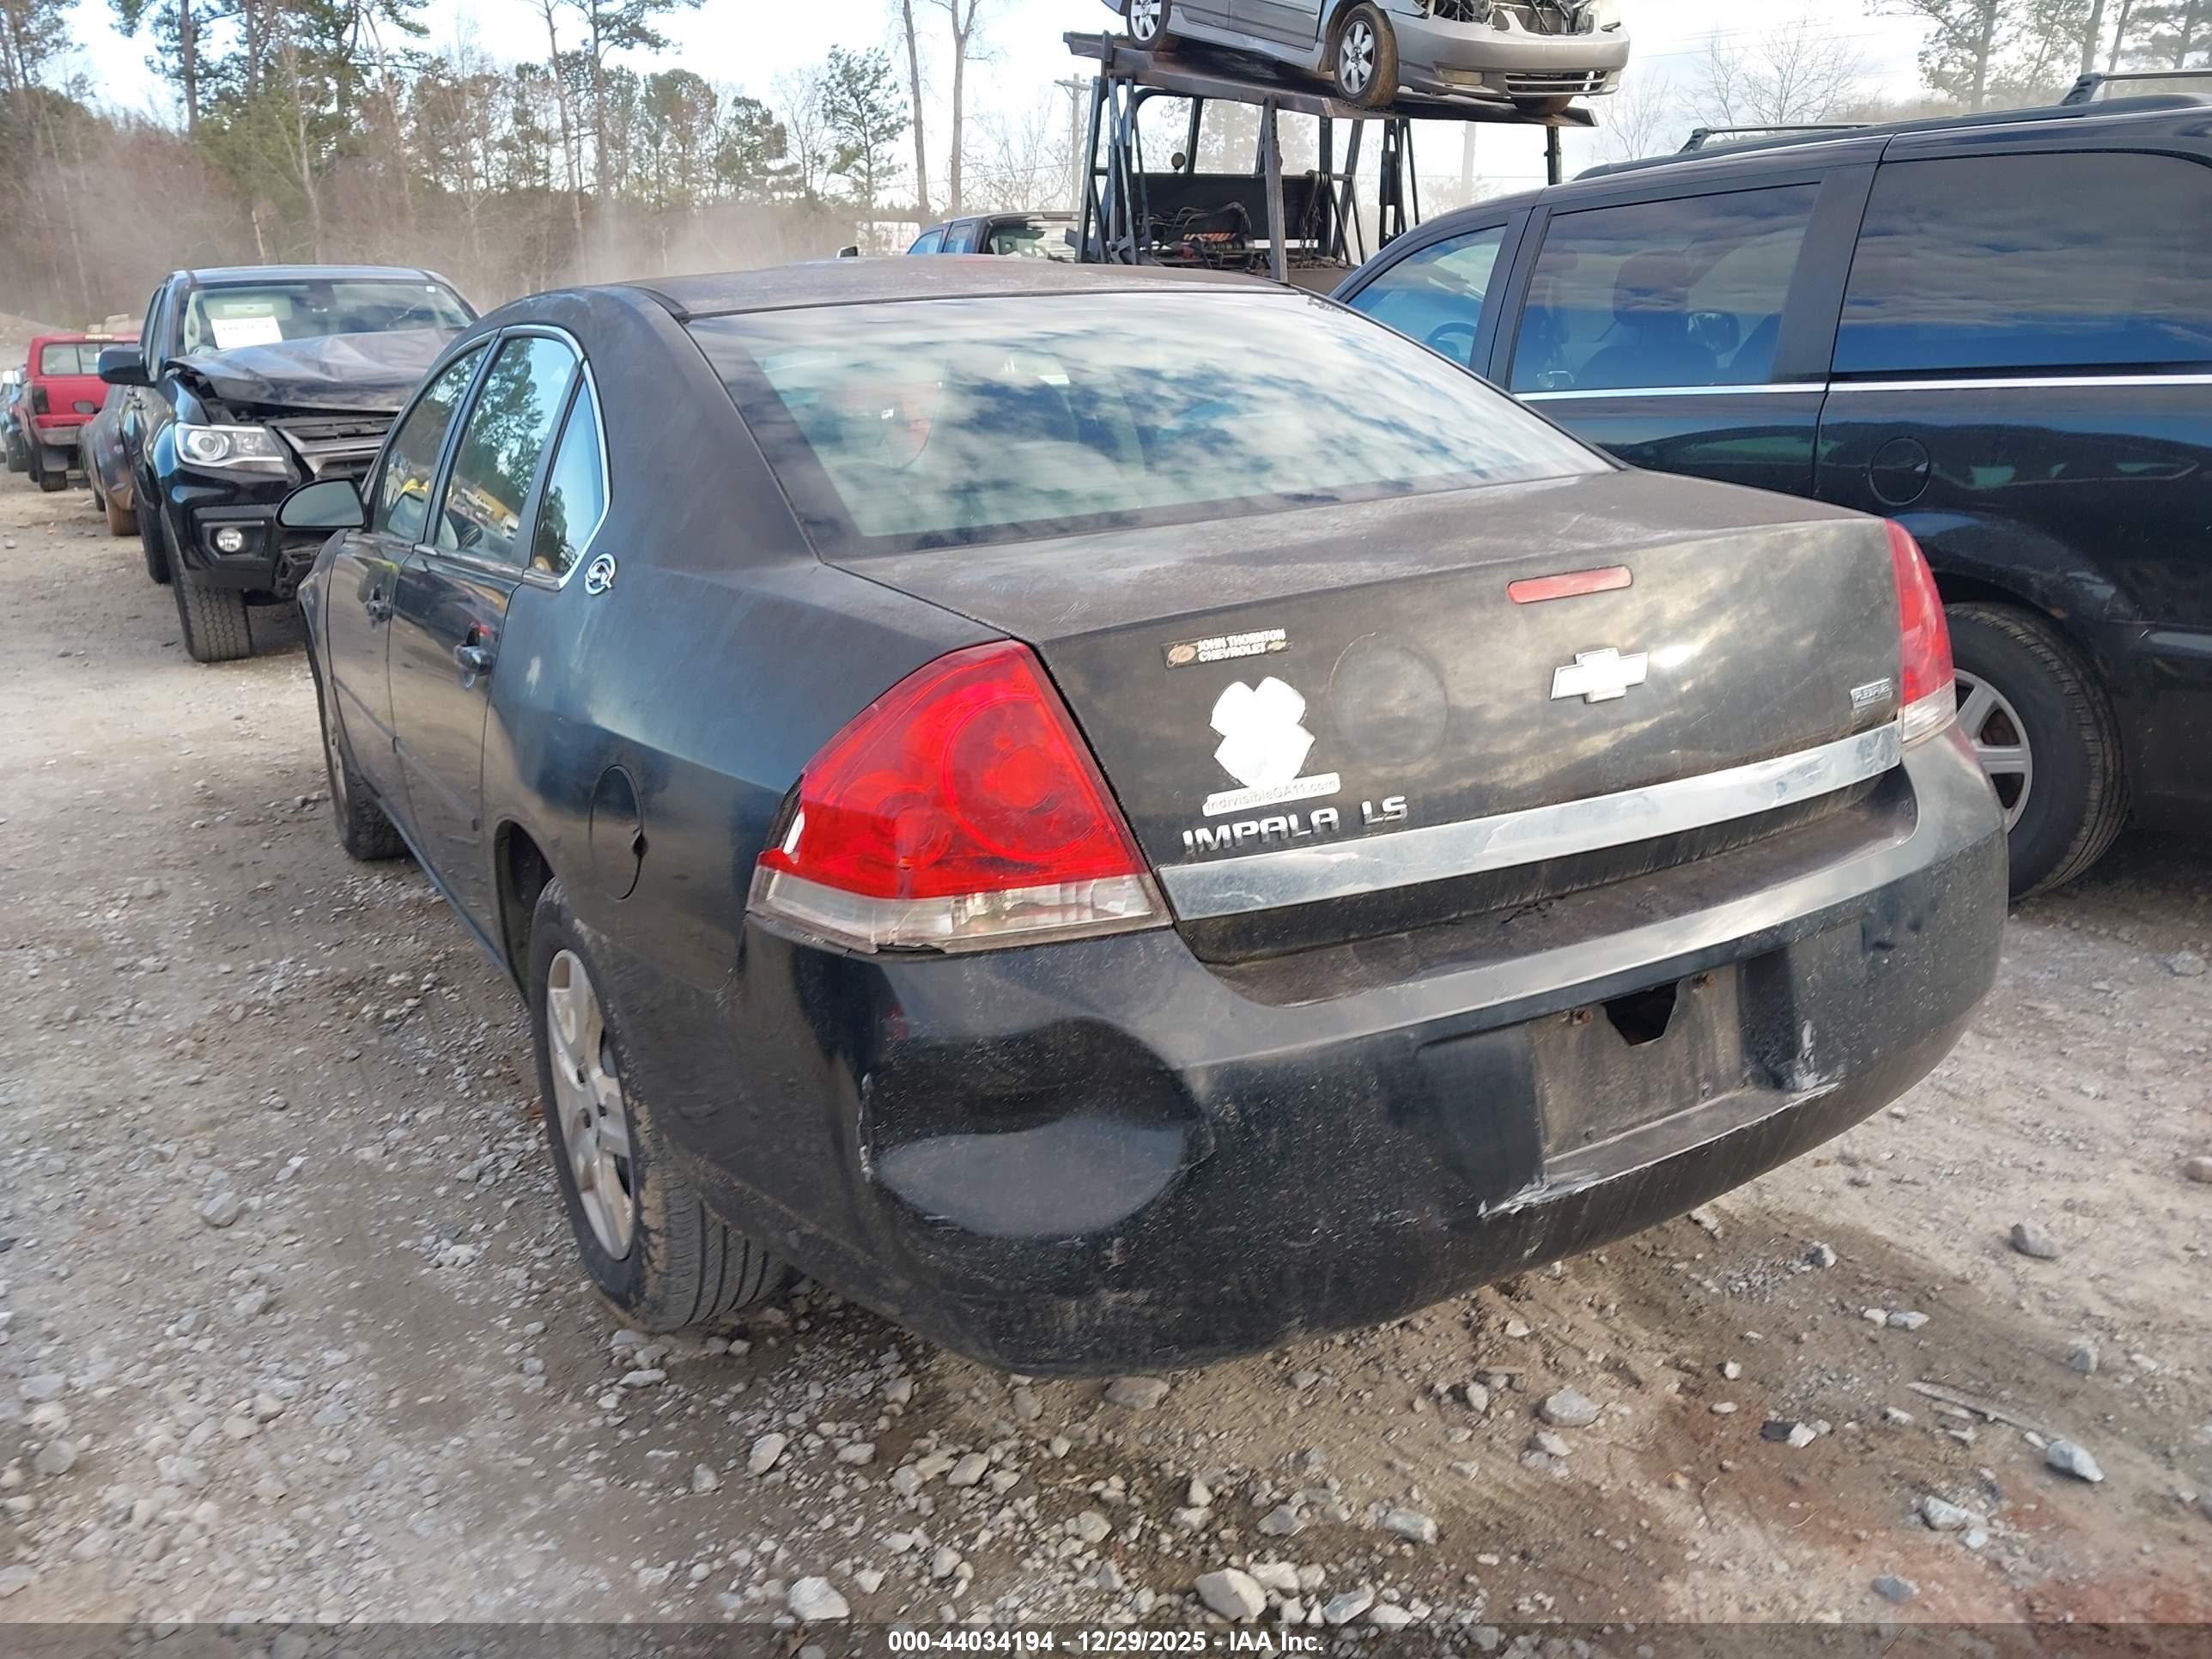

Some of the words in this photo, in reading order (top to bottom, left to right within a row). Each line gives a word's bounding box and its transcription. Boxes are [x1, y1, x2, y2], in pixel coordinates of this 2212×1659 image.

[1197, 636, 1227, 653] JOHN
[1226, 629, 1286, 647] THORNTON
[1198, 642, 1267, 662] CHEVROLET
[1182, 807, 1340, 854] IMPALA
[1361, 795, 1408, 825] LS
